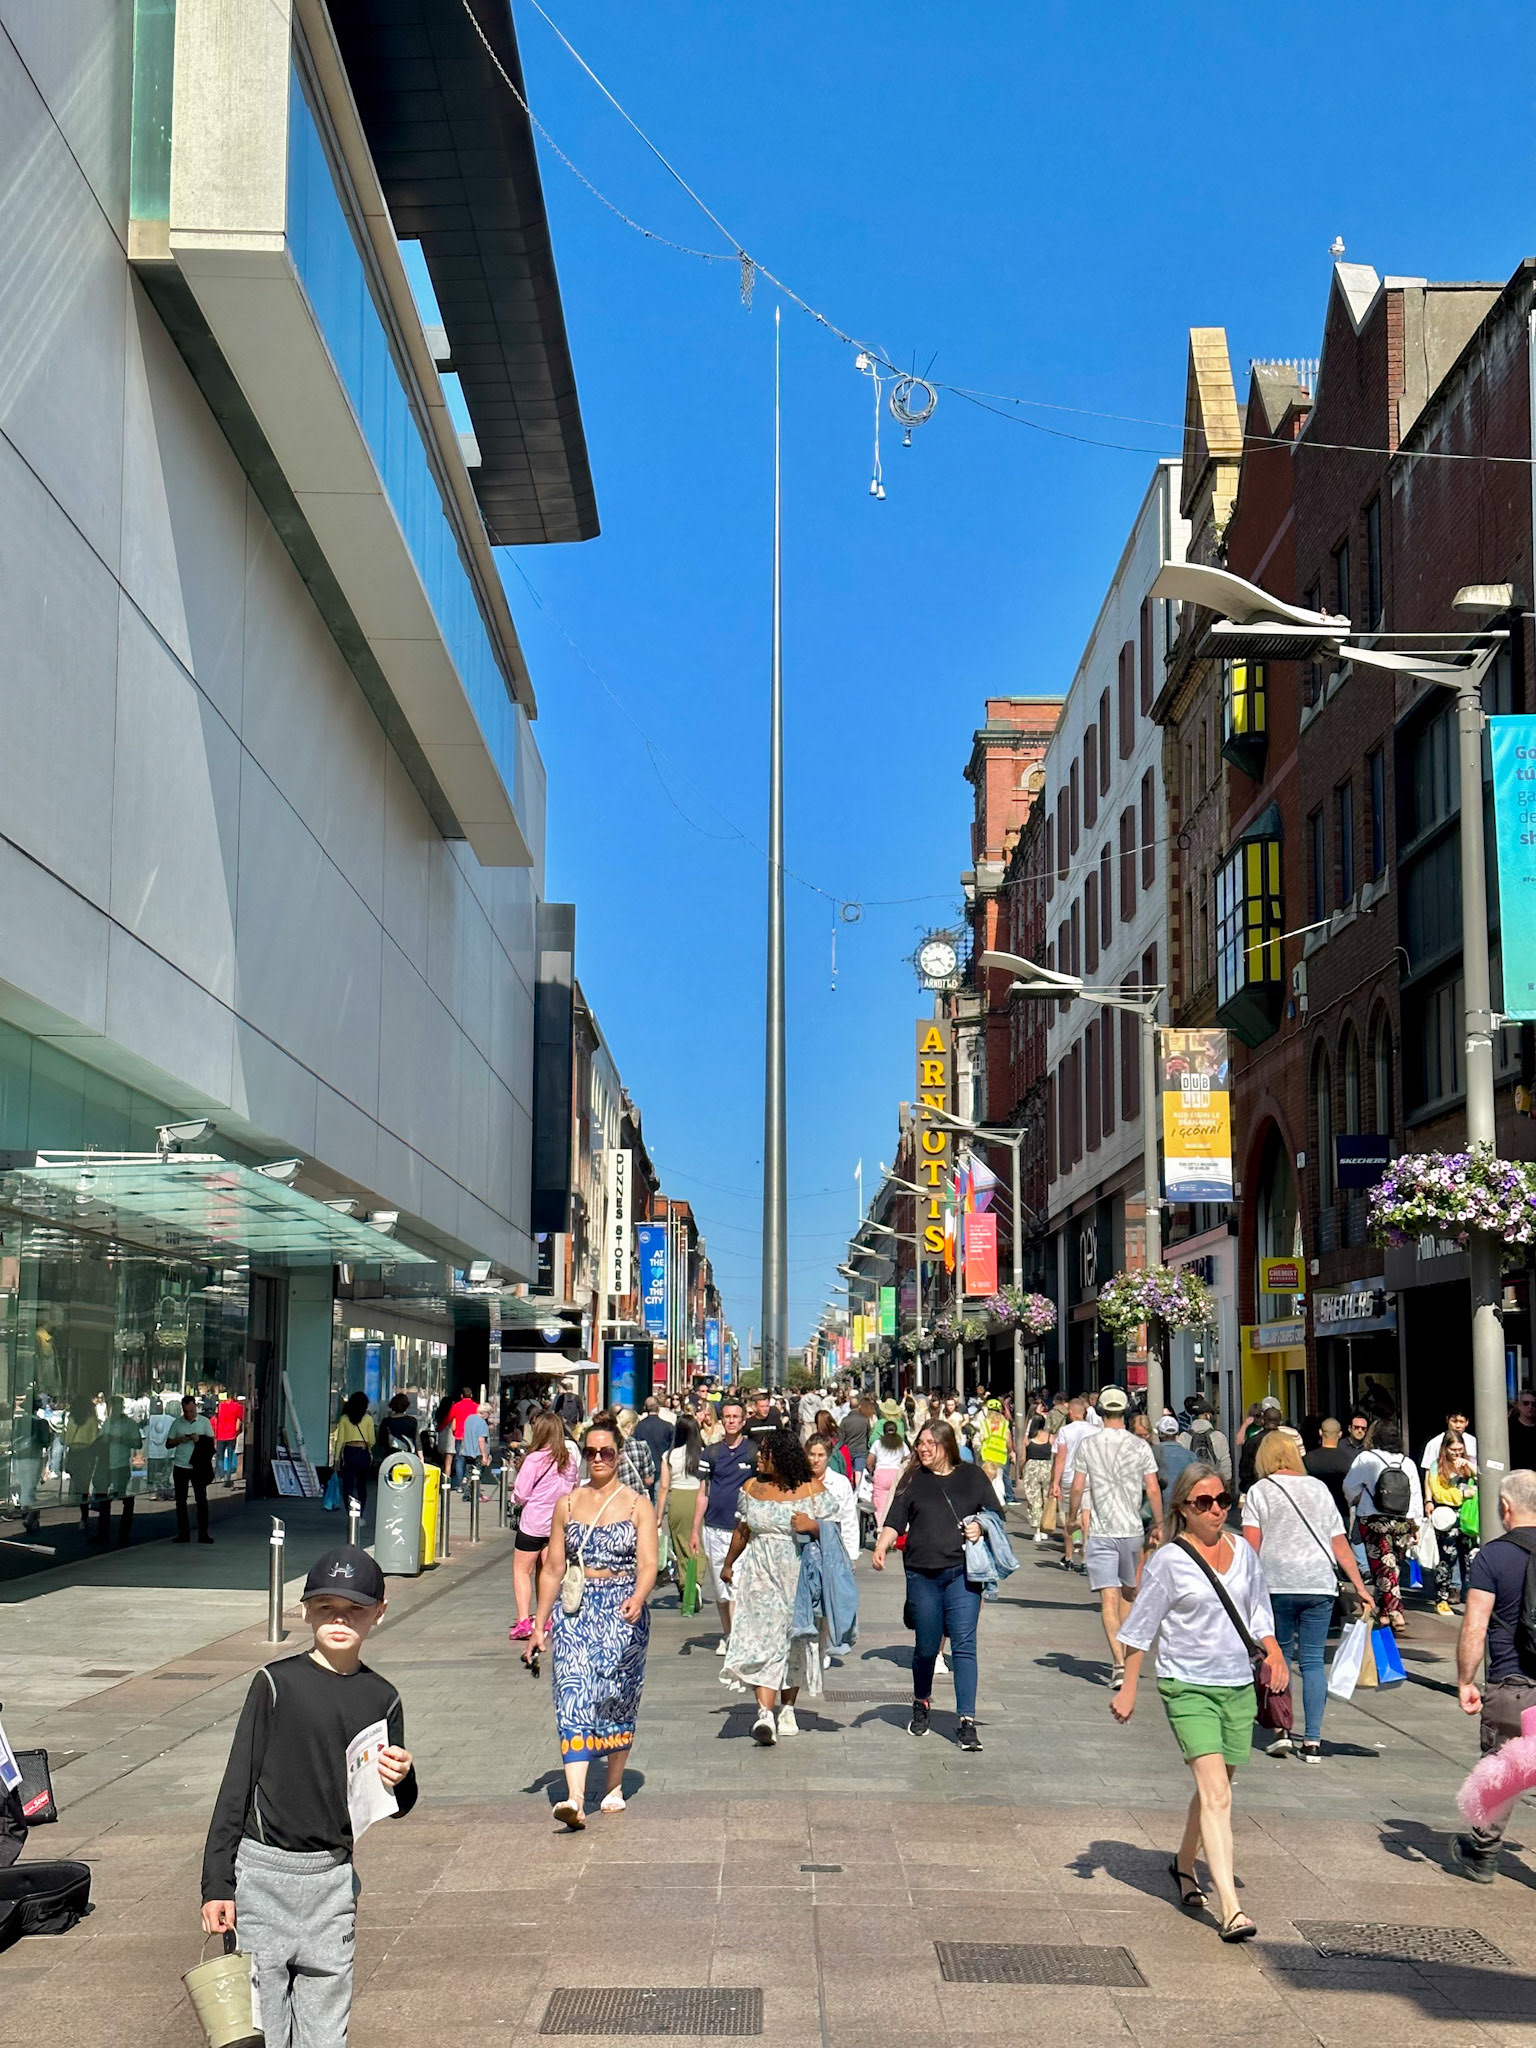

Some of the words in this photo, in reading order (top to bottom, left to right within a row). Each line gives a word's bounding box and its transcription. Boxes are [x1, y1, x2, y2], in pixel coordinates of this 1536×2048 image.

[1183, 1077, 1208, 1089] DUB
[1338, 1157, 1388, 1165] SKECHERS
[616, 1153, 625, 1220] DUNNES
[653, 1249, 664, 1258] AT
[614, 1225, 624, 1292] STORES
[649, 1258, 664, 1267] THE
[1268, 1269, 1298, 1277] CHEMIST
[651, 1279, 664, 1287] OF
[649, 1287, 664, 1296] THE
[644, 1296, 664, 1305] CITY
[1319, 1290, 1375, 1324] SKECHERS
